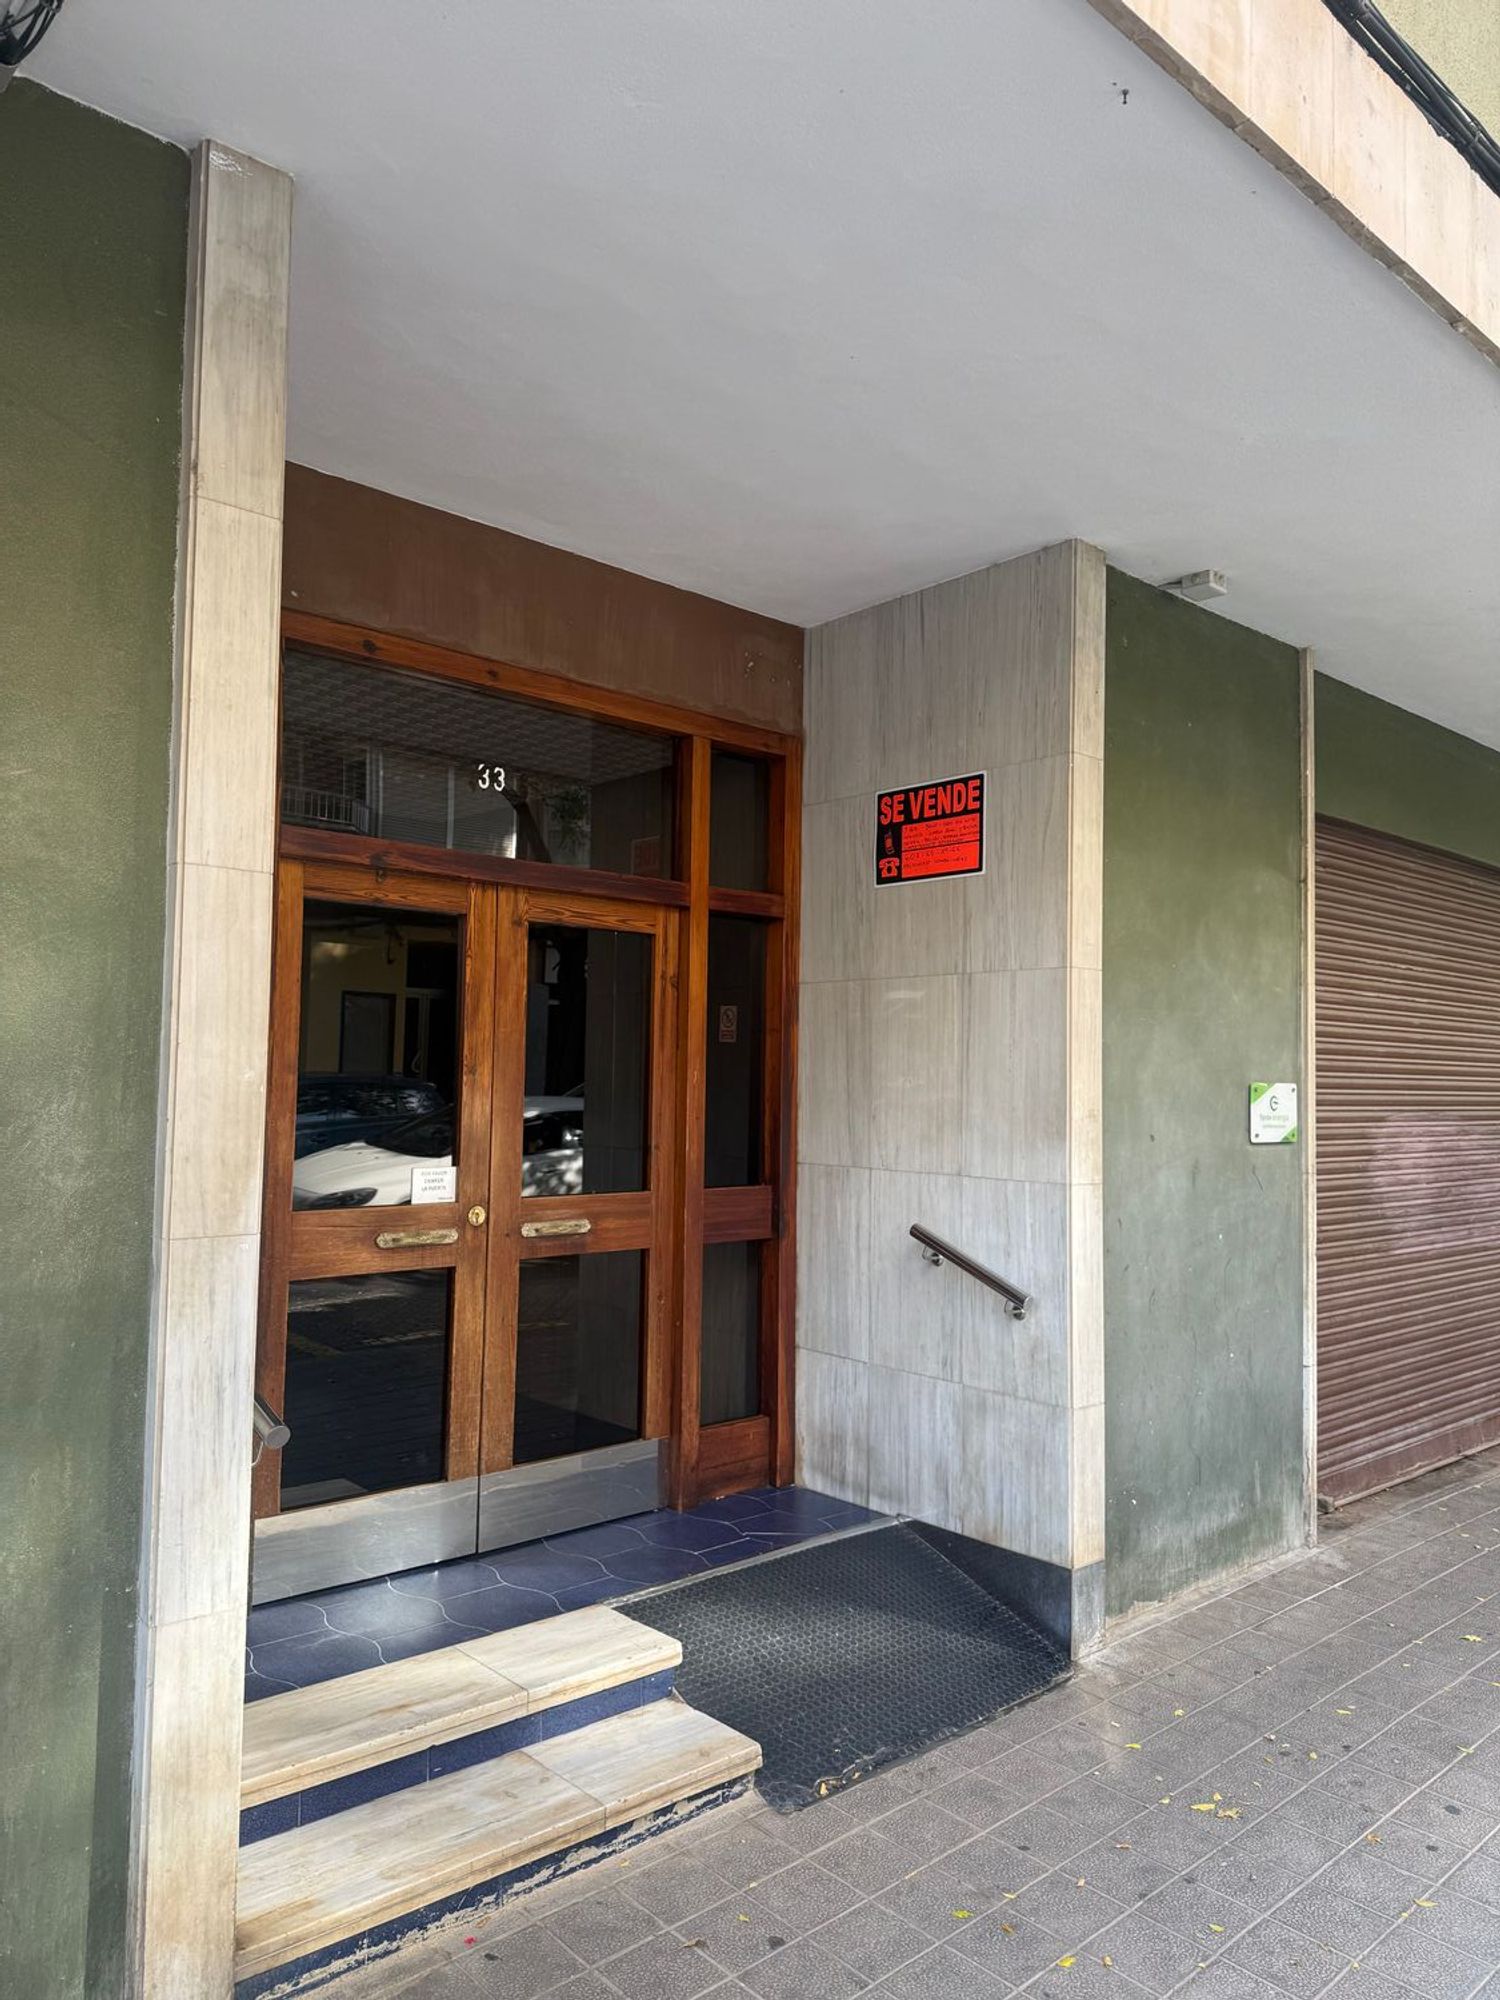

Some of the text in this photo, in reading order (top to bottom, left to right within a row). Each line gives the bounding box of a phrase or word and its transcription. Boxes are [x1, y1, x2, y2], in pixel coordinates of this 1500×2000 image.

[478, 763, 505, 791] 33
[880, 779, 980, 825] SE VENDE
